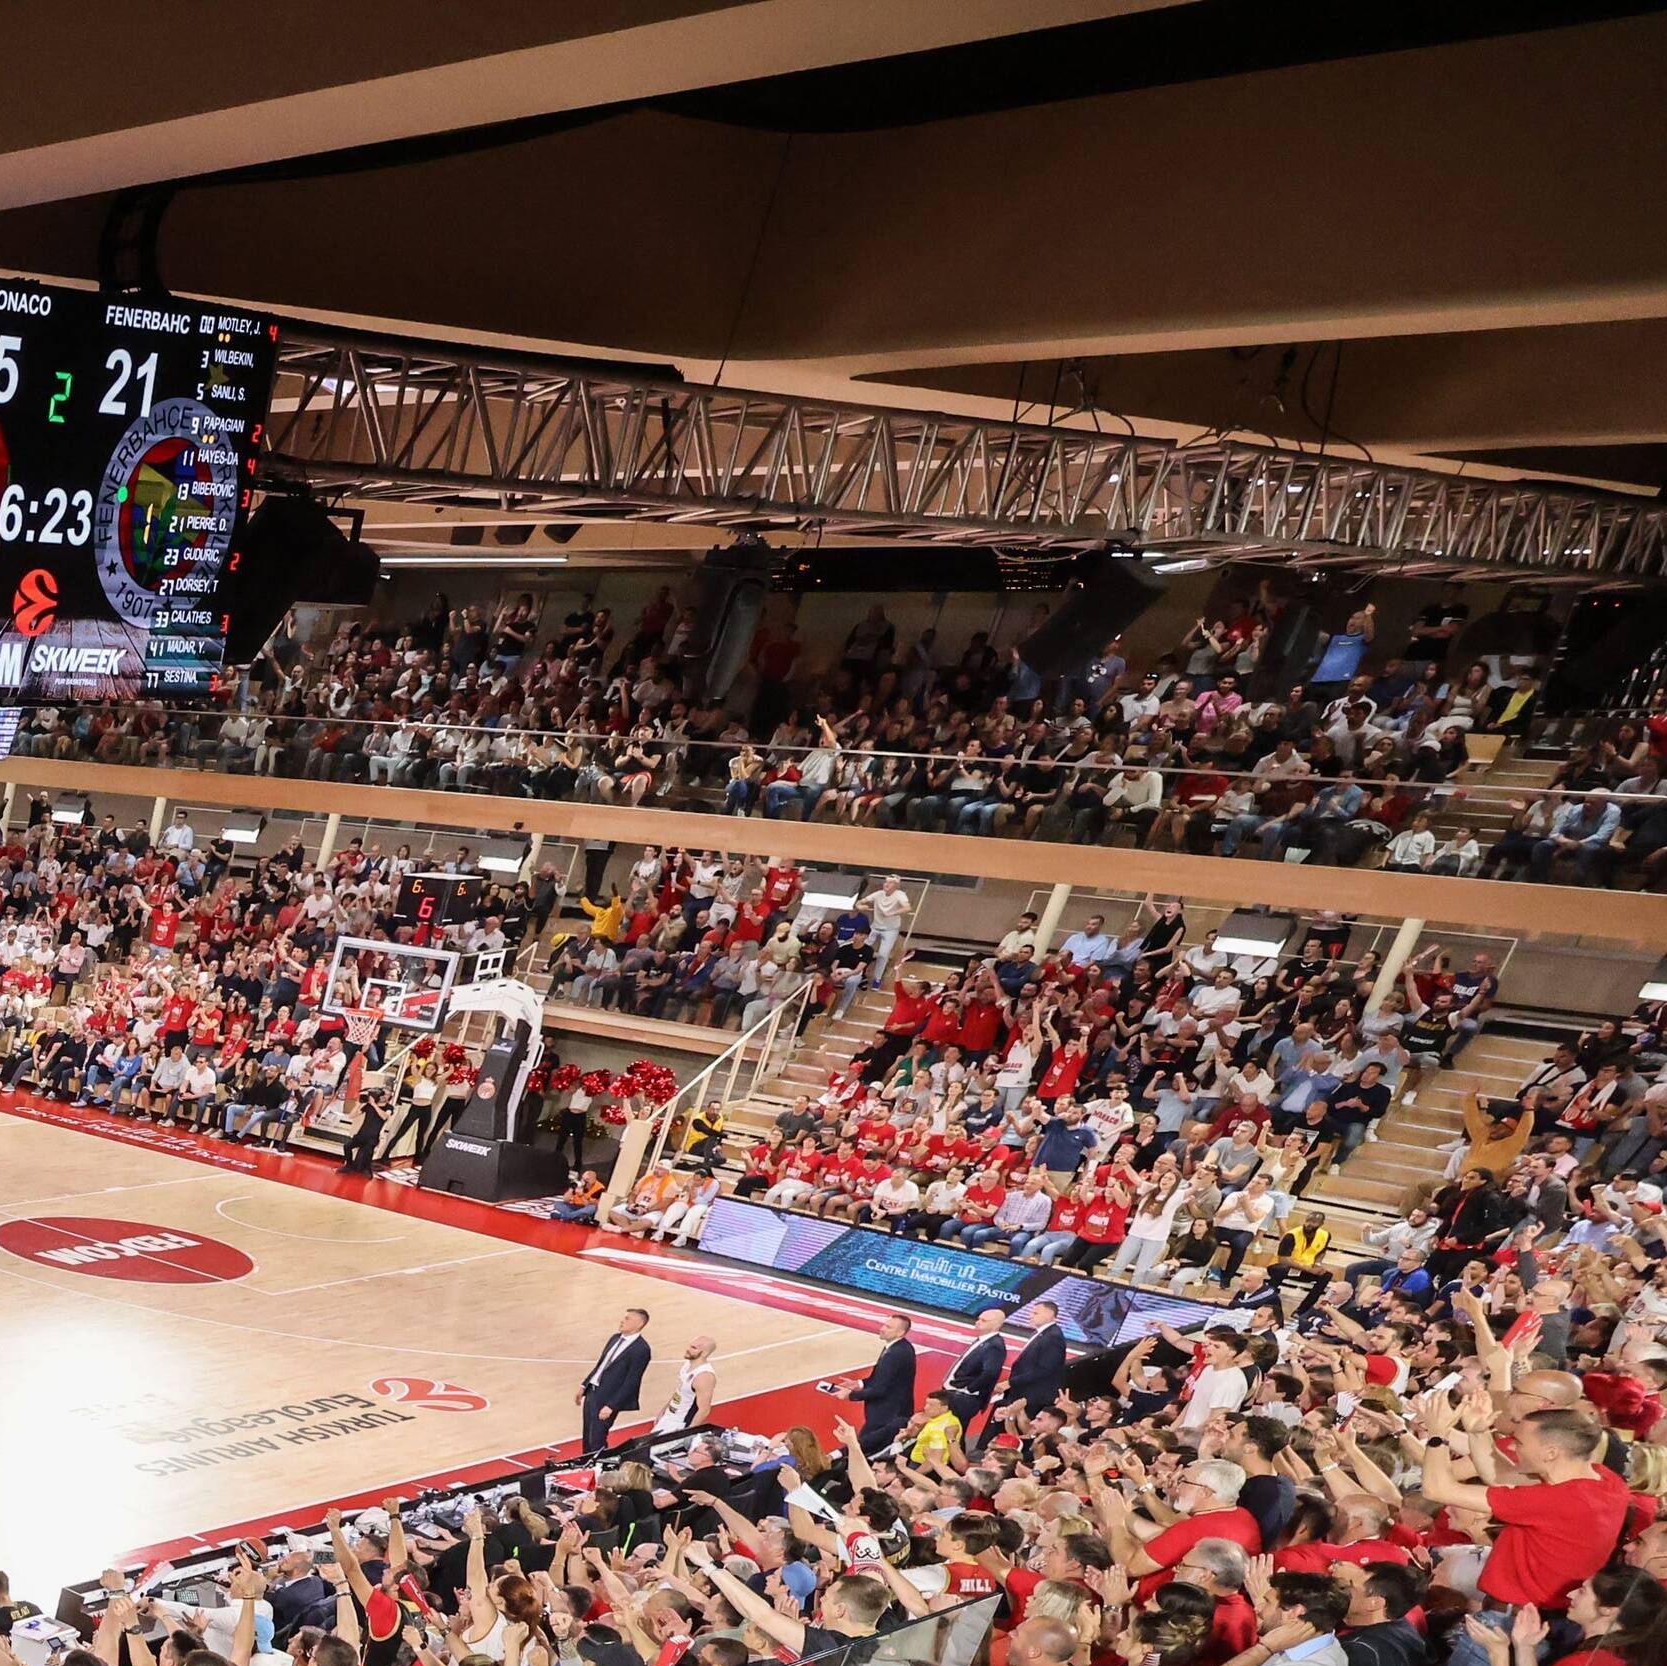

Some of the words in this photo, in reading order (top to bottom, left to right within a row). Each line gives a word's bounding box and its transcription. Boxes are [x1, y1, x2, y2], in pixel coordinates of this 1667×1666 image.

[105, 305, 191, 334] FENERBAHC
[199, 315, 215, 334] 00
[218, 316, 253, 336] MOTLEY,
[253, 320, 261, 335] J.
[269, 325, 279, 342] 4
[201, 351, 209, 368] 3
[214, 349, 254, 368] WILBEKIN,
[98, 348, 158, 418] 21
[196, 383, 205, 401] 5
[211, 384, 236, 401] SANLI,
[237, 388, 246, 401] S.
[49, 371, 72, 423] 2
[190, 416, 199, 434] 9
[203, 416, 245, 433] PAPAGIAN
[252, 424, 263, 443] 2
[183, 450, 194, 467] 11
[198, 449, 239, 466] HAYES-DA
[247, 458, 256, 476] 4
[178, 483, 189, 500] 13
[192, 481, 235, 498] BIBEROVIC
[241, 489, 251, 508] 3
[143, 503, 154, 545] 1
[169, 516, 184, 533] 21
[186, 516, 217, 532] PIERRE,
[218, 517, 227, 532] D.
[164, 548, 179, 565] 23
[183, 547, 220, 564] GUDURIC,
[229, 552, 240, 570] 2
[115, 581, 154, 620] 1907
[159, 579, 174, 596] 27
[176, 578, 211, 594] DORSEY,
[212, 580, 219, 592] T
[154, 611, 169, 628] 33
[171, 609, 212, 625] CALATHES
[30, 644, 127, 676] SKWEEK
[150, 641, 163, 657] 41
[167, 640, 196, 655] MADAR,
[197, 641, 206, 654] Y.
[146, 673, 159, 689] 77
[164, 670, 199, 685] SESTINA,
[418, 897, 436, 918] 6
[446, 1138, 492, 1156] SKWEEK
[35, 1233, 203, 1266] FEDCOM
[866, 1258, 911, 1280] CENTRE
[910, 1268, 977, 1294] IMMOBILIER
[976, 1283, 1022, 1304] PASTOR
[275, 1409, 416, 1445] TURKISH
[134, 1436, 283, 1477] AIRLINES
